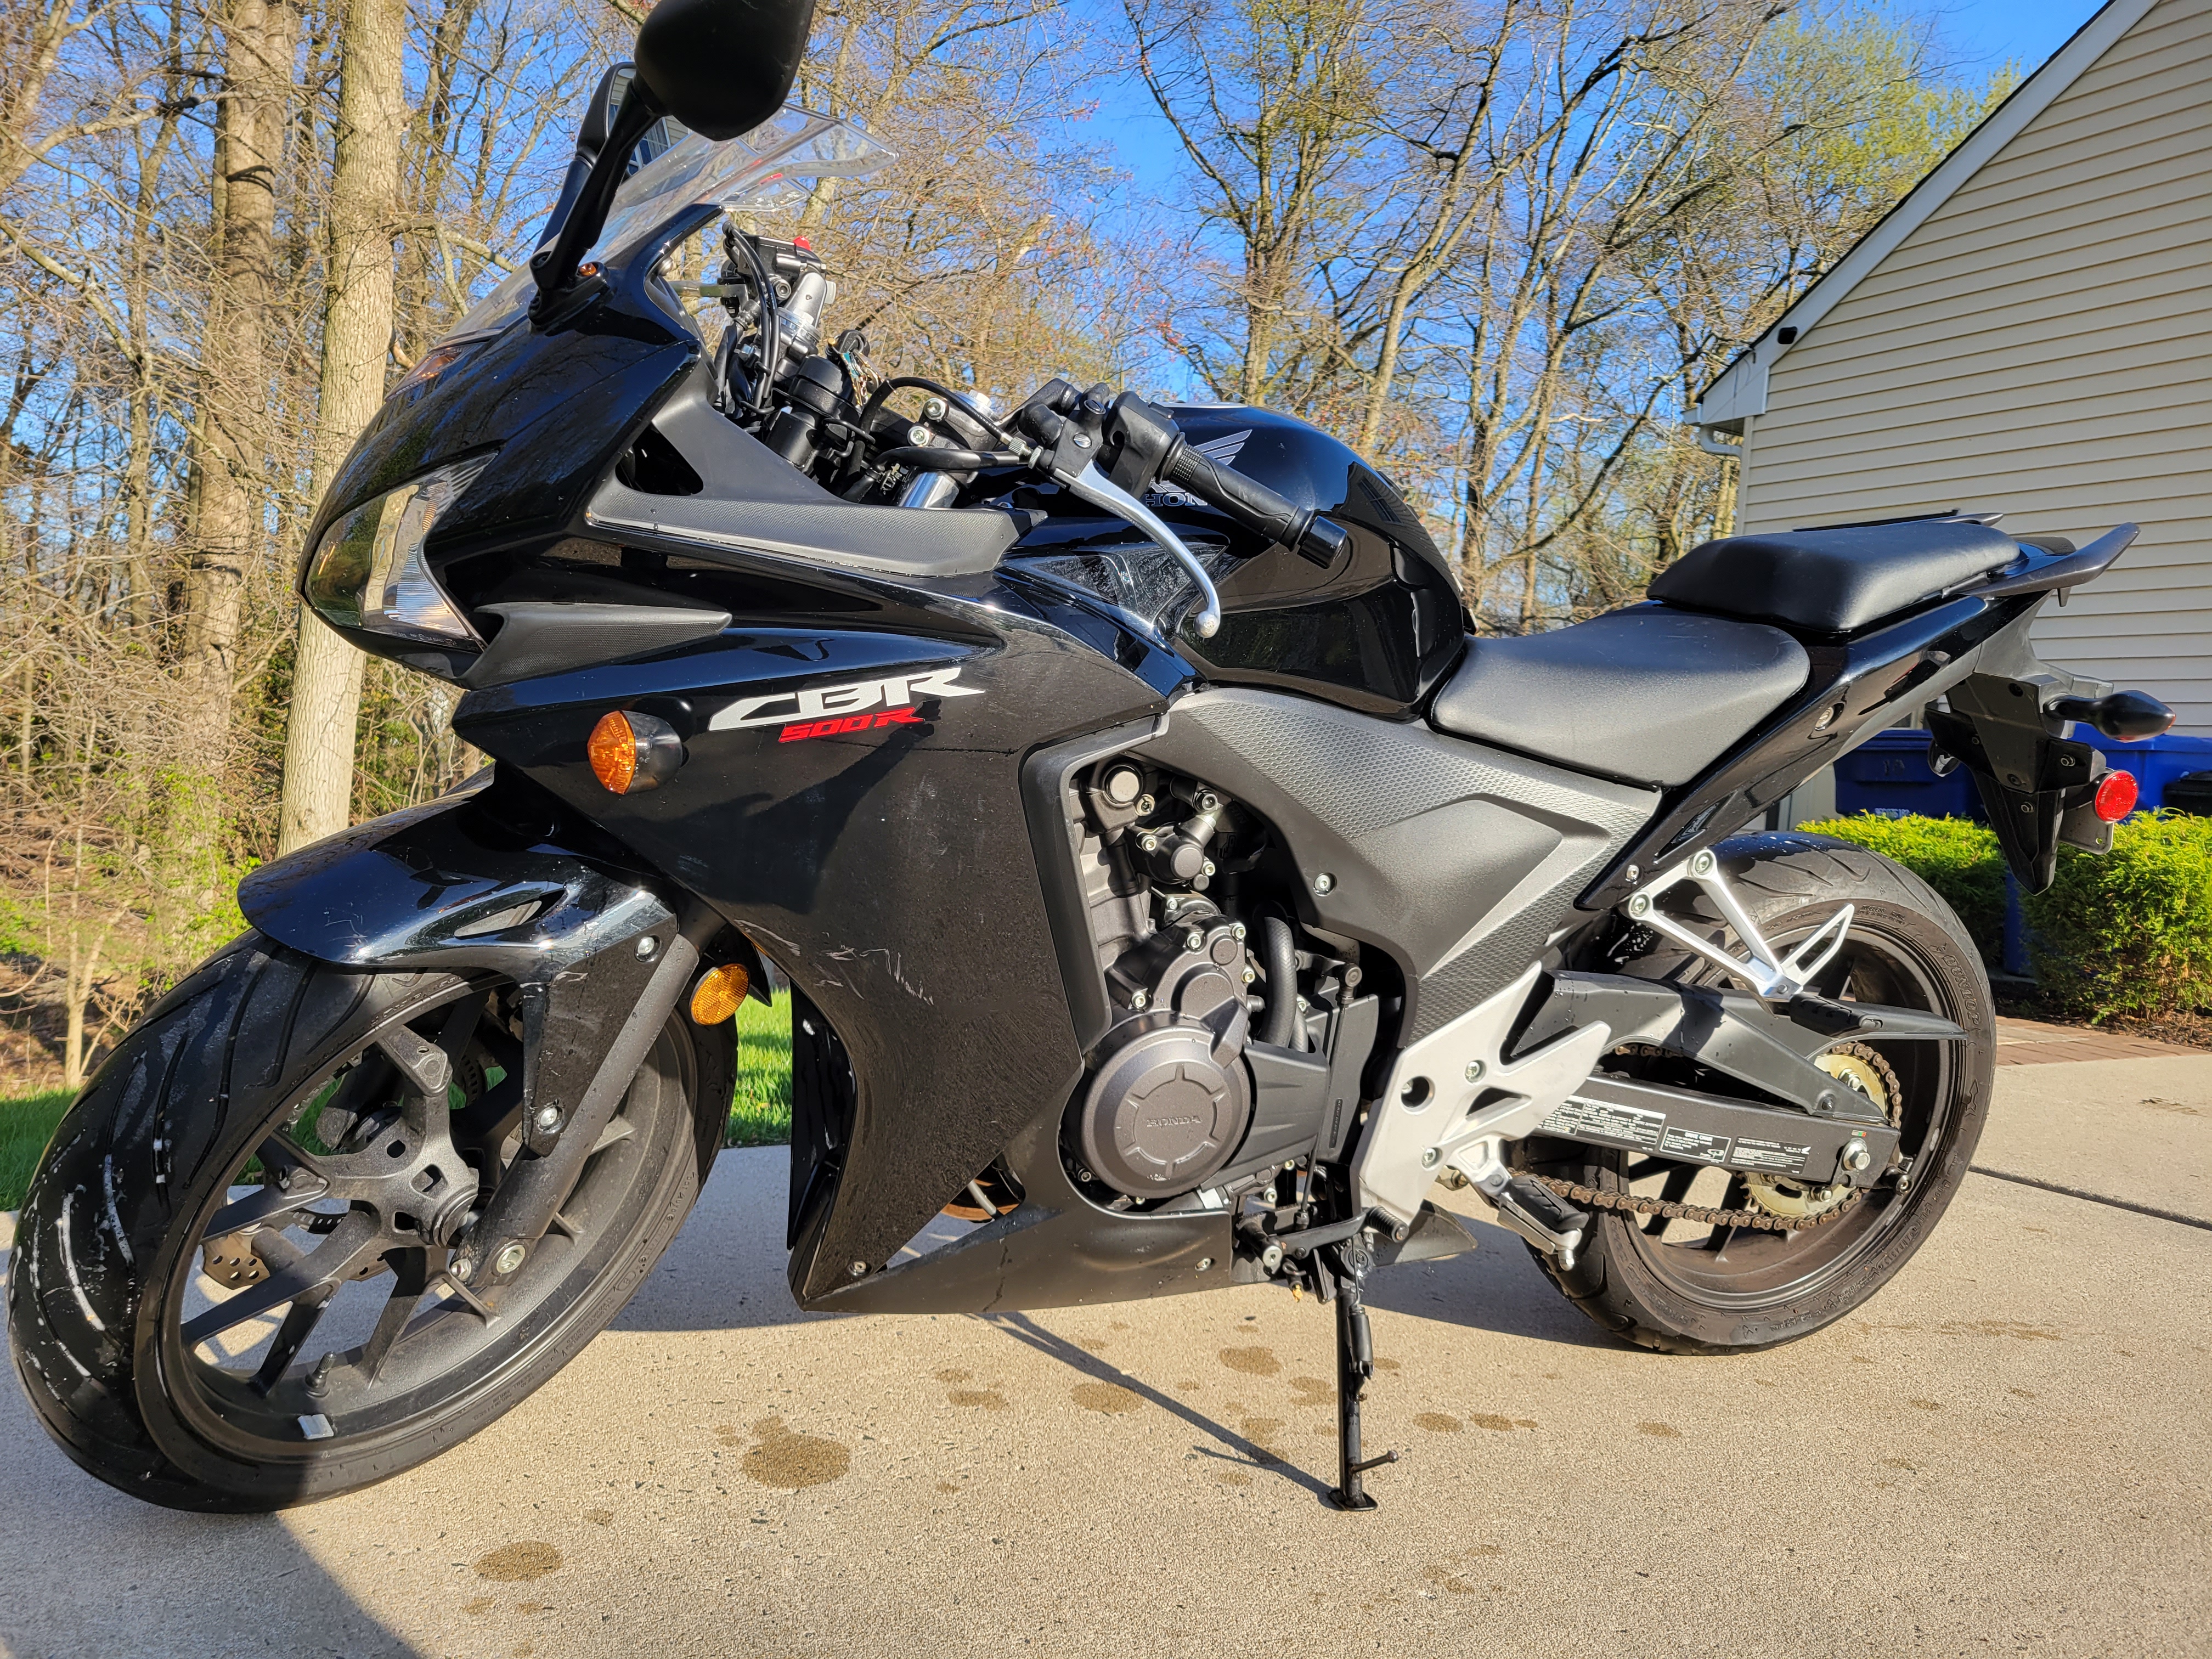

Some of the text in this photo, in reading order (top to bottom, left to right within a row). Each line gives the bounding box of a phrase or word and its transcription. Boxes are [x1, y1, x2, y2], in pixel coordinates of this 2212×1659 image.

[1144, 493, 1208, 507] HON
[707, 667, 985, 731] CBR
[778, 707, 925, 743] 500R
[1942, 954, 1981, 1025] DUNLOP
[1146, 1115, 1202, 1127] HONDA
